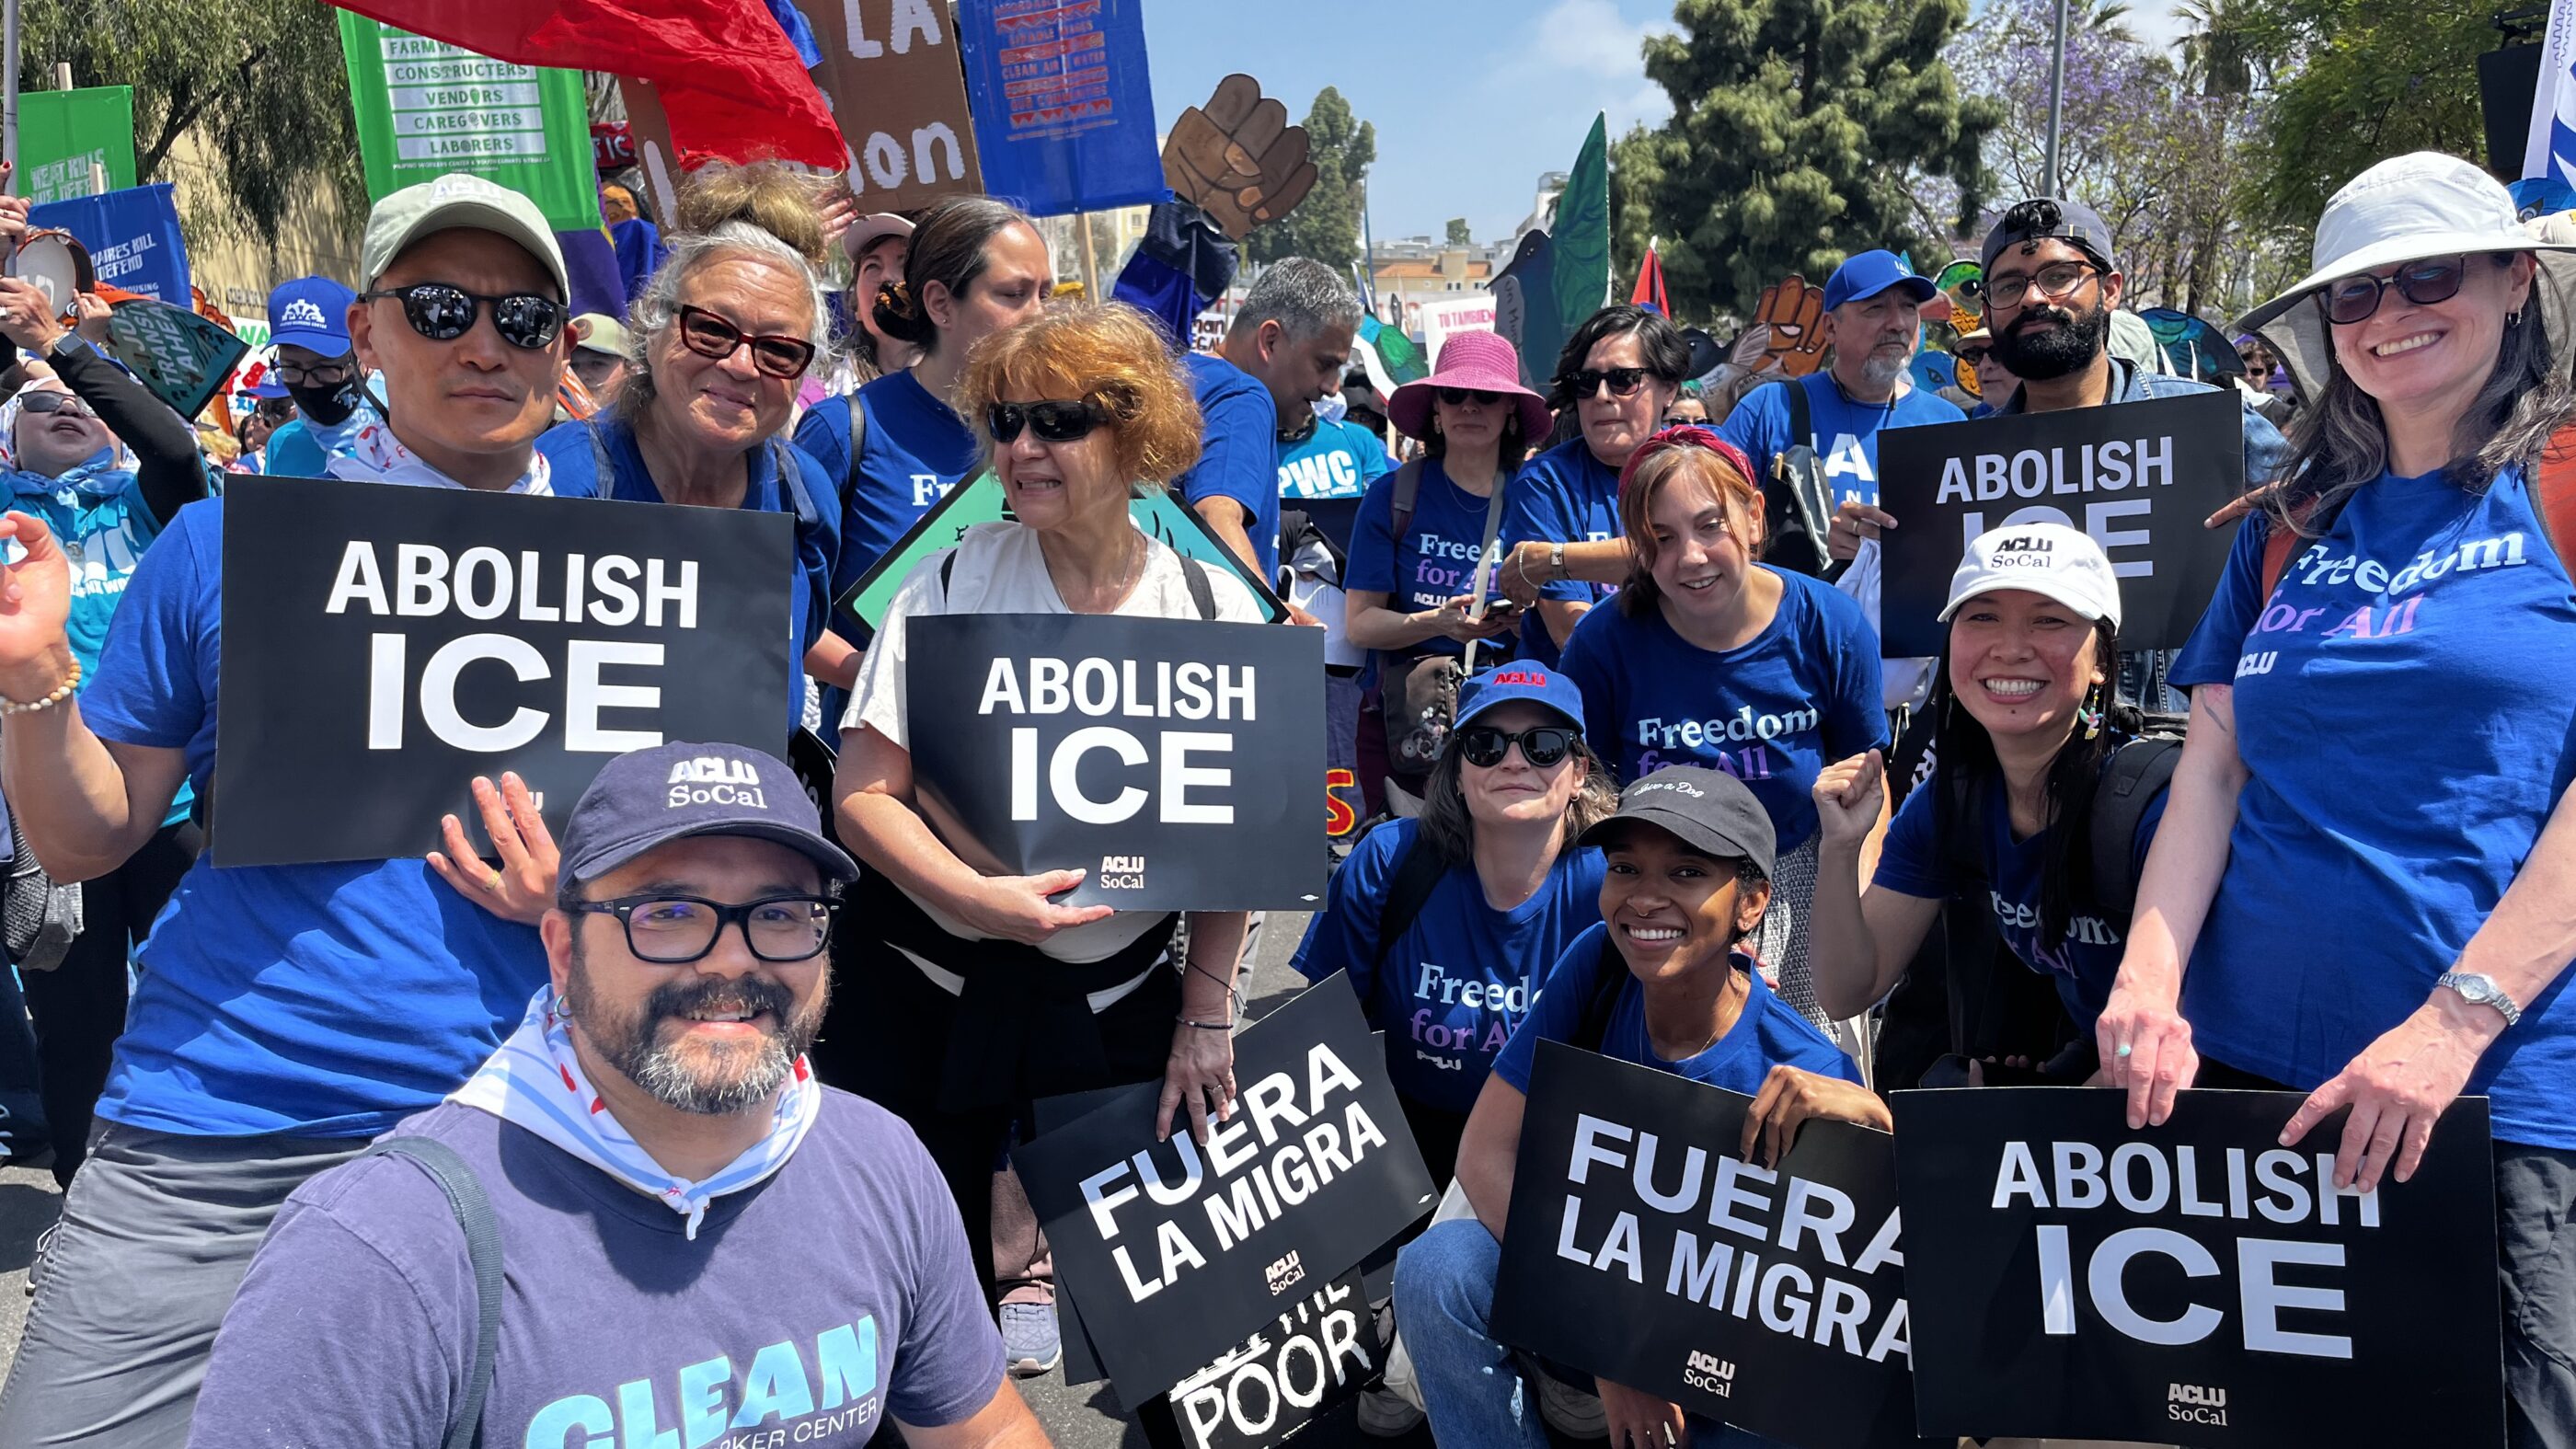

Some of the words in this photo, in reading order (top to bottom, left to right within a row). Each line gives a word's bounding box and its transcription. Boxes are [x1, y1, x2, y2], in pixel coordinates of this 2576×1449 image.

[1936, 436, 2173, 504] ABOLISH
[1963, 499, 2154, 578] IE
[1995, 536, 2053, 553] ACLU
[1415, 558, 1462, 587] for
[1991, 555, 2052, 569] SoCal
[2283, 532, 2527, 596] Freedom
[325, 540, 699, 629] ABOLISH
[1413, 592, 1448, 608] ACLU
[2320, 592, 2425, 638] All
[1492, 671, 1547, 688] ACLU
[2235, 650, 2278, 680] ACLU
[368, 632, 665, 753] ICE
[978, 657, 1256, 721] ABOLISH
[1638, 705, 1818, 750] Freedom
[668, 756, 761, 786] ACLU
[1011, 726, 1234, 824] ICE
[1675, 782, 1705, 799] Dog
[668, 786, 768, 810] SoCal
[1100, 856, 1144, 874] ACLU
[1100, 874, 1144, 889] SoCal
[1414, 962, 1543, 1014] Freed
[1410, 1008, 1475, 1052] for
[1078, 1042, 1363, 1240] FUERA
[1111, 1219, 1207, 1304] LA
[1202, 1100, 1387, 1252] MIGRA
[1992, 1141, 2380, 1228] ABOLISH
[1264, 1249, 1301, 1284] ACLU
[1270, 1264, 1306, 1296] SoCal
[1557, 1194, 1643, 1284] LA
[1665, 1229, 1914, 1372] MIGRA
[2036, 1225, 2353, 1360] ICE
[525, 1314, 879, 1449] CLEAN
[1182, 1308, 1373, 1449] POOR
[1683, 1368, 1731, 1398] SoCal
[1686, 1349, 1736, 1380] ACLU
[2168, 1383, 2226, 1407] ACLU
[2168, 1404, 2227, 1427] SoCal
[714, 1429, 786, 1449] RKER
[793, 1397, 878, 1445] CENTER
